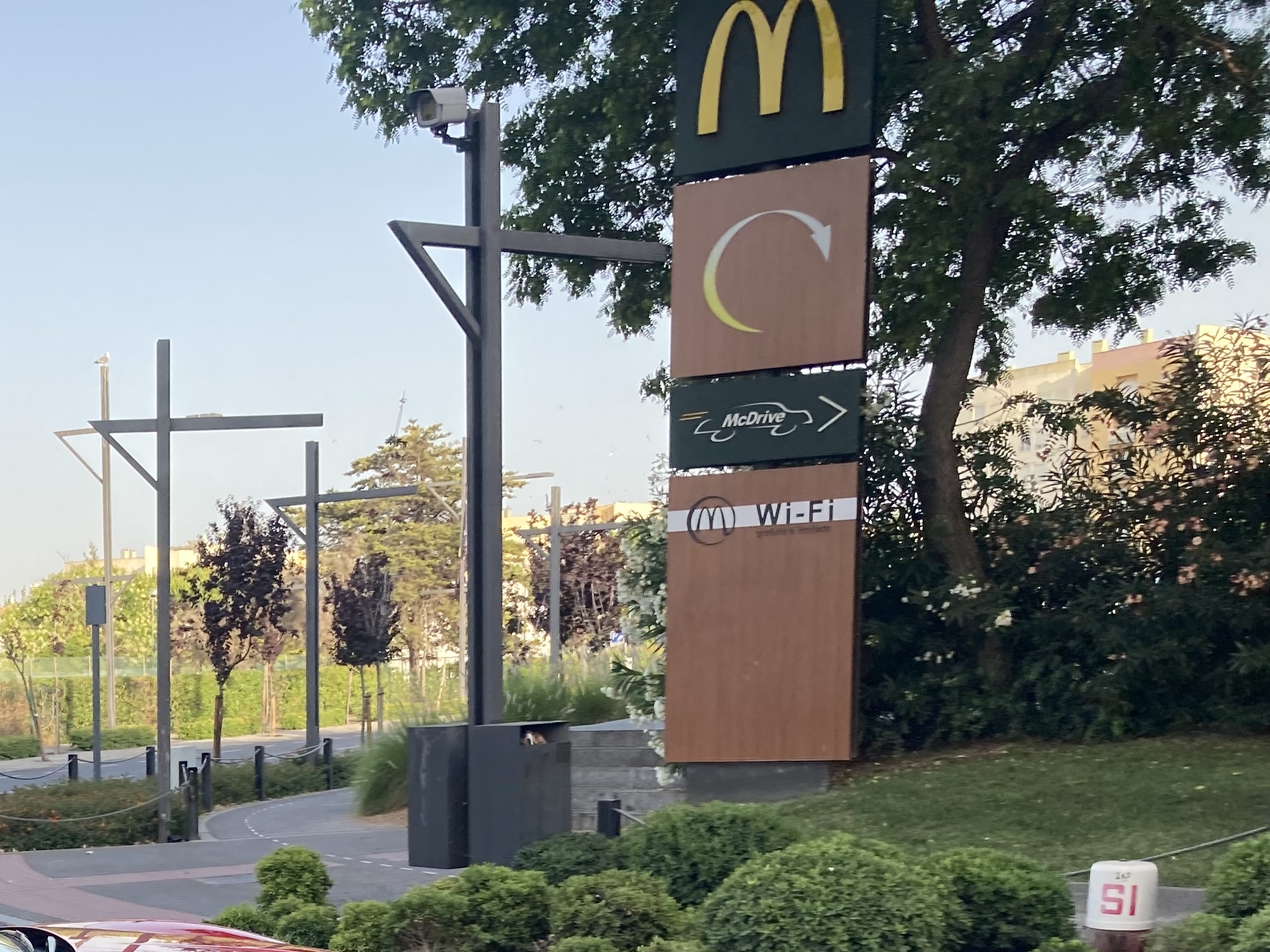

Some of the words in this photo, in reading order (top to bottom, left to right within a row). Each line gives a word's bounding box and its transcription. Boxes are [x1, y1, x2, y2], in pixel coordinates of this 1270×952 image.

[721, 410, 786, 428] McDrive
[756, 499, 834, 527] Wi-Fi
[1100, 883, 1138, 916] SI
